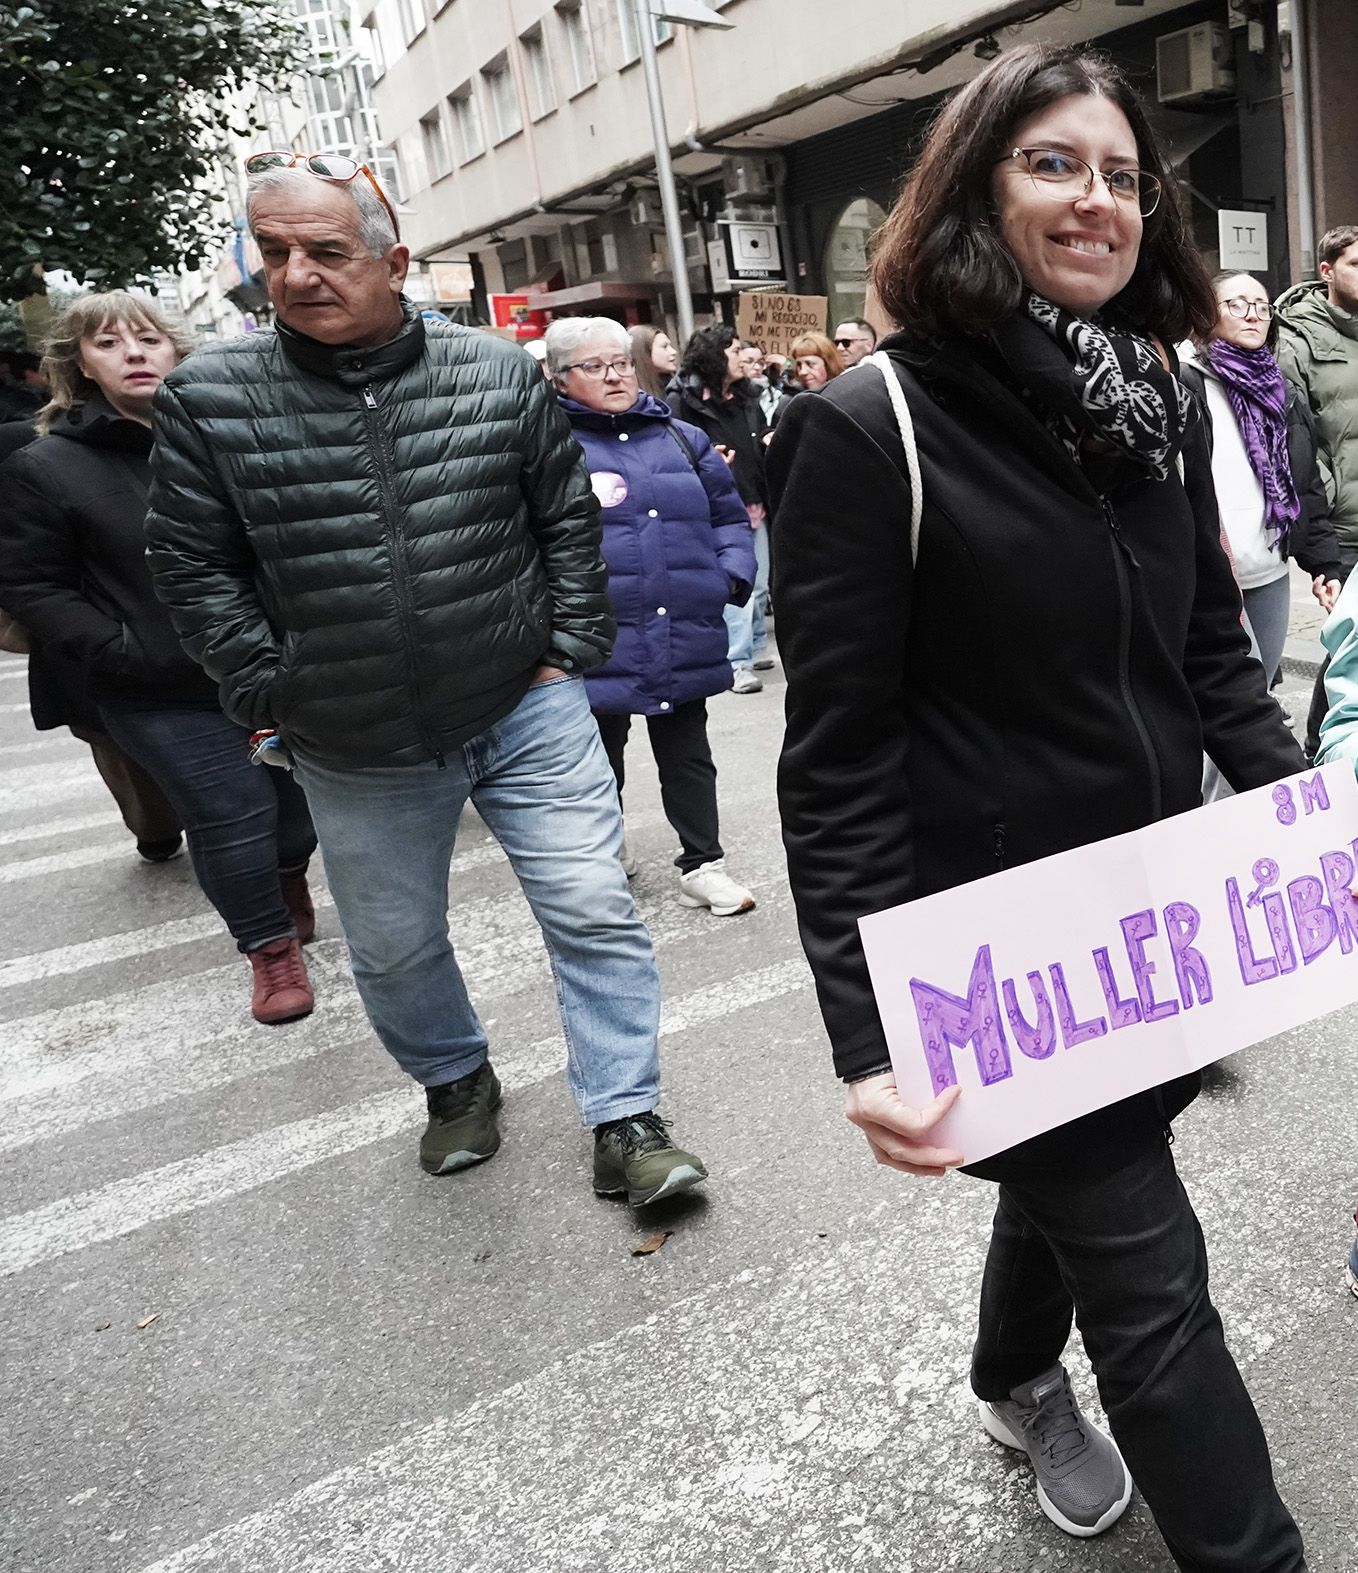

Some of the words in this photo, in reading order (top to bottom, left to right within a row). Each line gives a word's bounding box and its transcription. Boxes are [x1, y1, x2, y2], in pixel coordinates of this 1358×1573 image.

[1232, 226, 1256, 243] TT
[768, 297, 784, 312] NO
[749, 325, 763, 337] NO
[909, 900, 1214, 1100] MULLER
